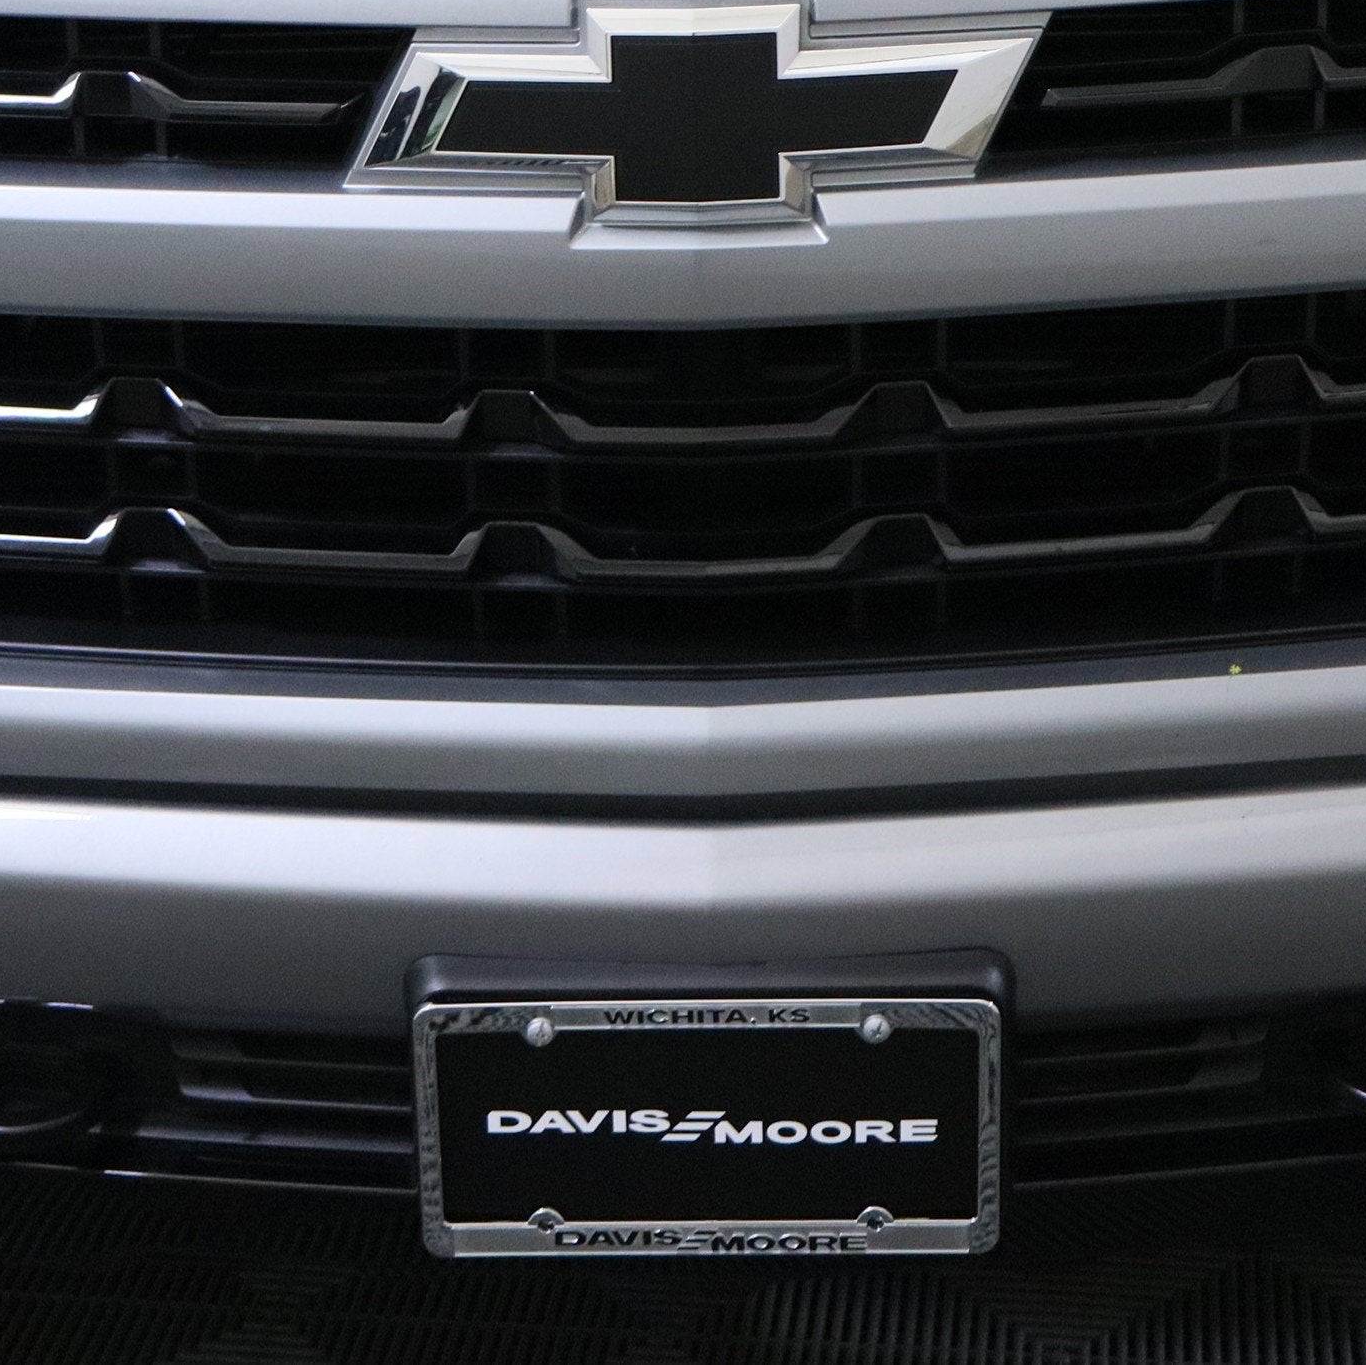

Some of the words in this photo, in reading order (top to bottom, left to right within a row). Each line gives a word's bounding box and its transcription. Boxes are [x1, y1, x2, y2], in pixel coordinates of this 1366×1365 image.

[767, 1008, 811, 1023] KS
[486, 1110, 671, 1134] DAVIS
[714, 1119, 939, 1145] MOORE
[554, 1230, 683, 1246] DAVIS
[710, 1233, 868, 1252] MOORE
